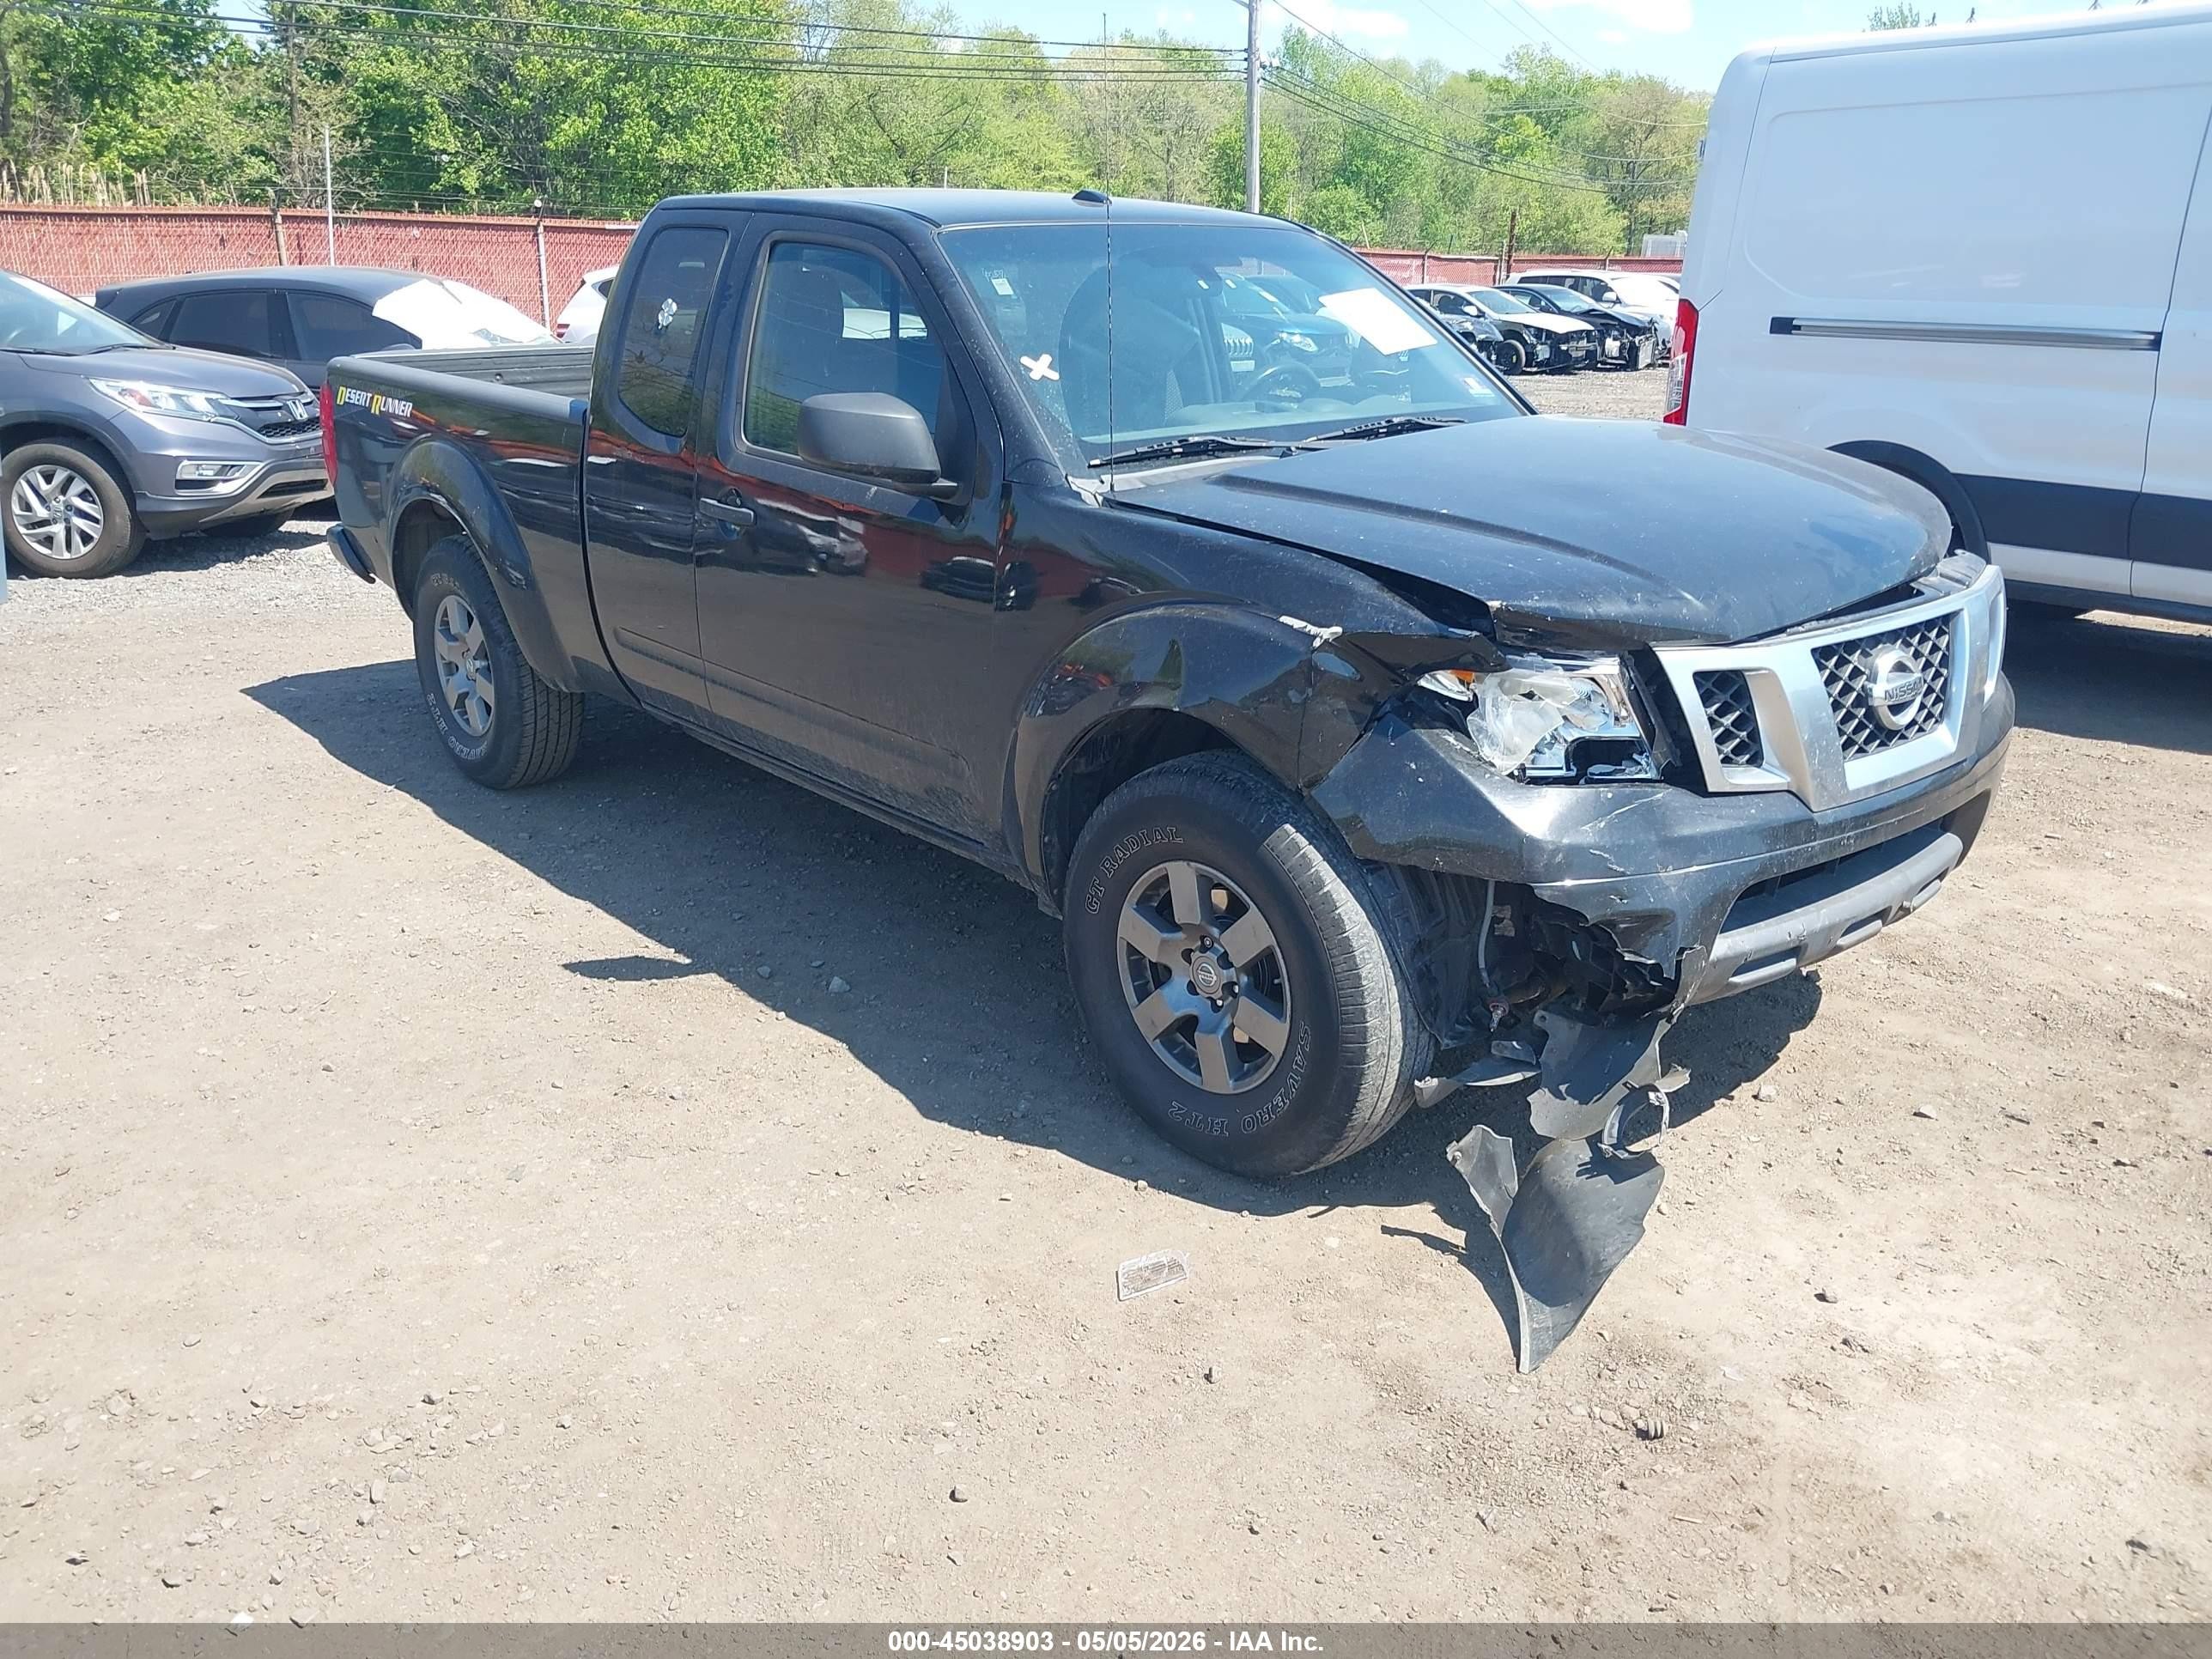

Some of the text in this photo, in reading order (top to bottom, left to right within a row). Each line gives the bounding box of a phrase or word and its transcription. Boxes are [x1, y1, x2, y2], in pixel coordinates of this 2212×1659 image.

[337, 386, 413, 417] DESERT RUNNER
[1884, 677, 1922, 702] NISSAN
[1085, 827, 1184, 915] GT RADIAL
[1168, 1021, 1311, 1137] SAVERO HT2
